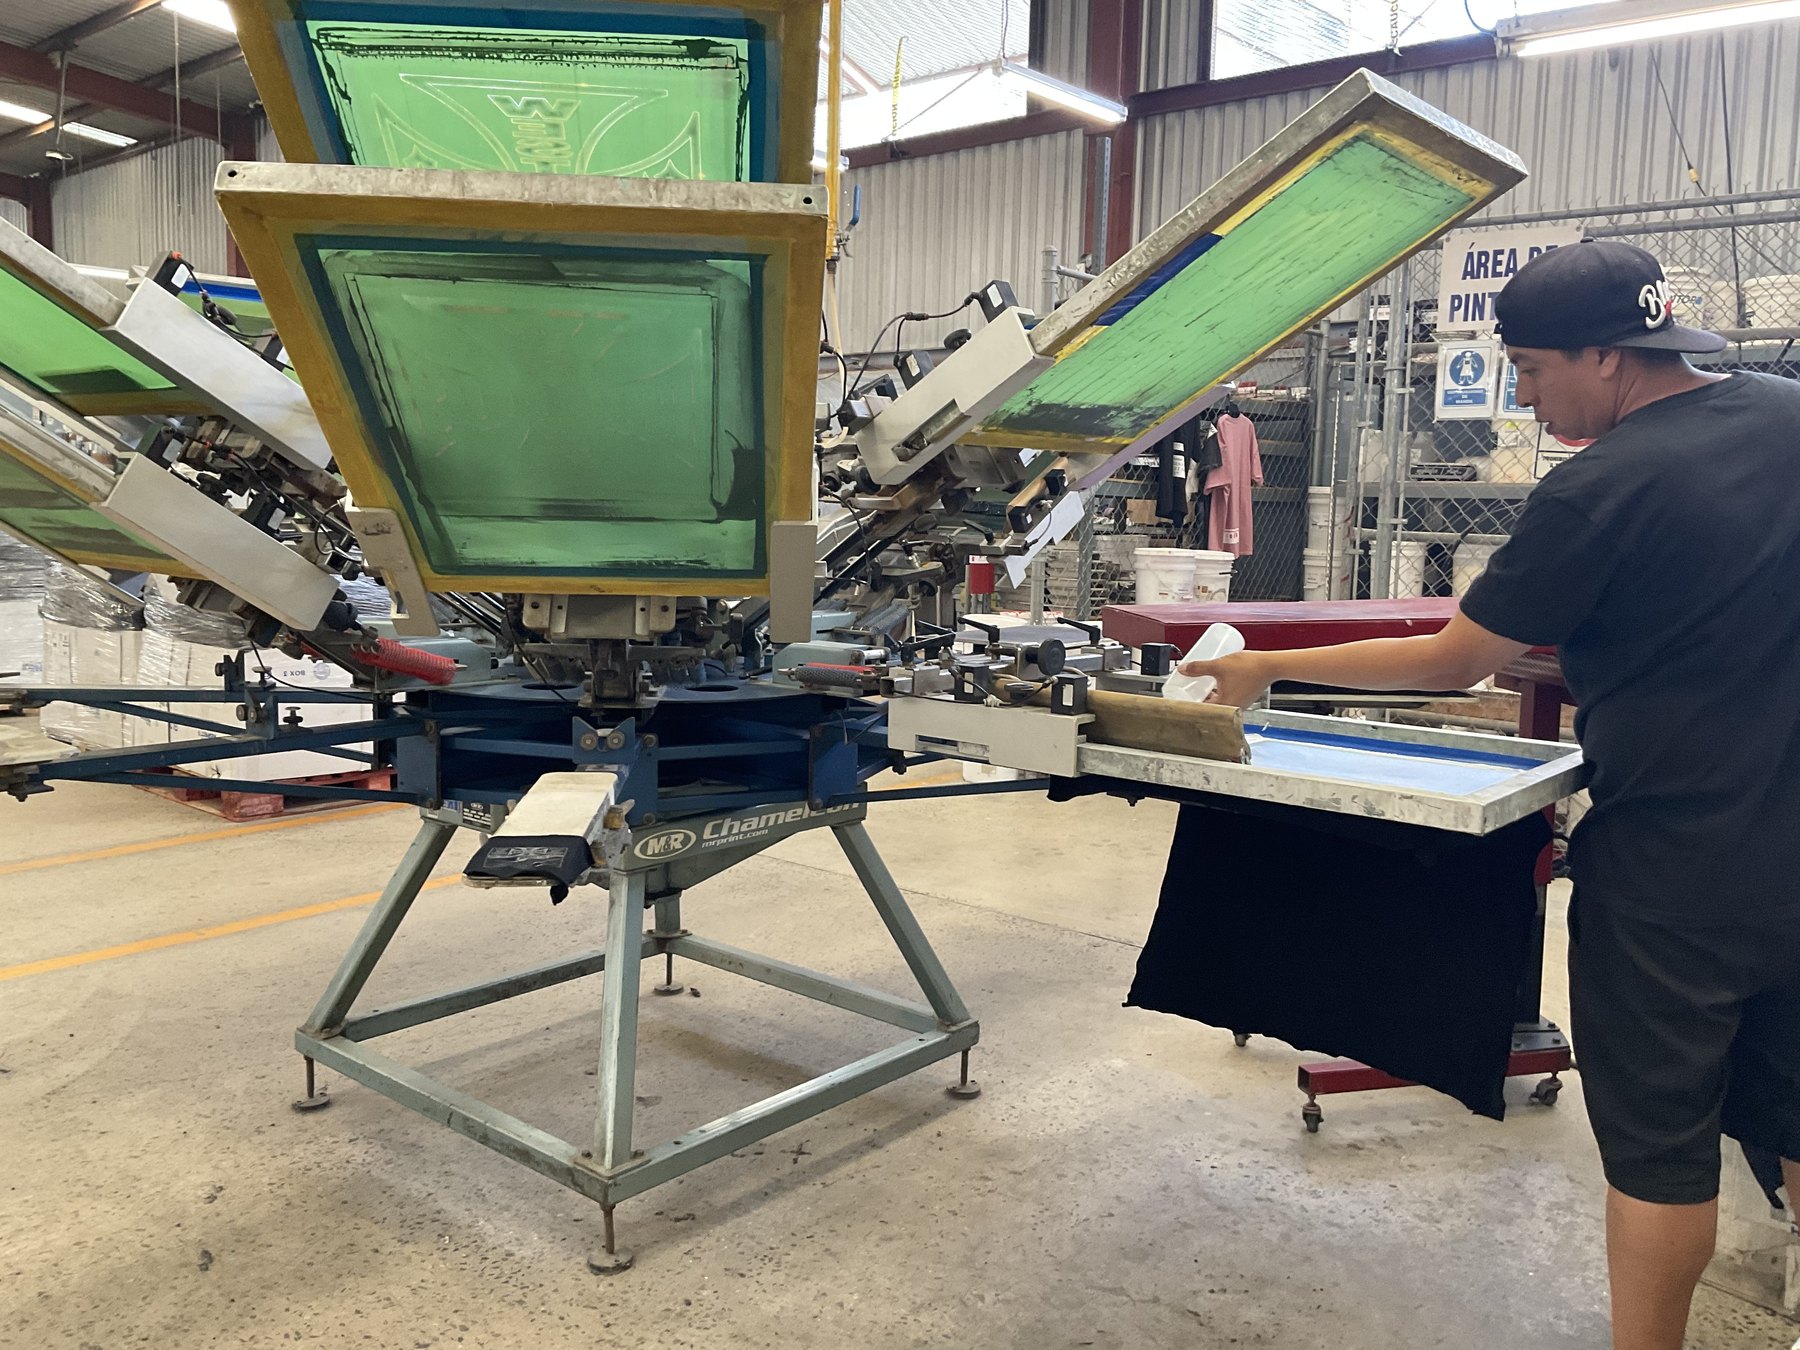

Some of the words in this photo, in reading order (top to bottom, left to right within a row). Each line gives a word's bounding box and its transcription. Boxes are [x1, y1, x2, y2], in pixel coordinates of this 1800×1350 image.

[1461, 242, 1518, 280] ÁREA
[1449, 292, 1501, 322] PINT
[646, 832, 685, 856] M&R
[701, 828, 769, 849] mrprint.com
